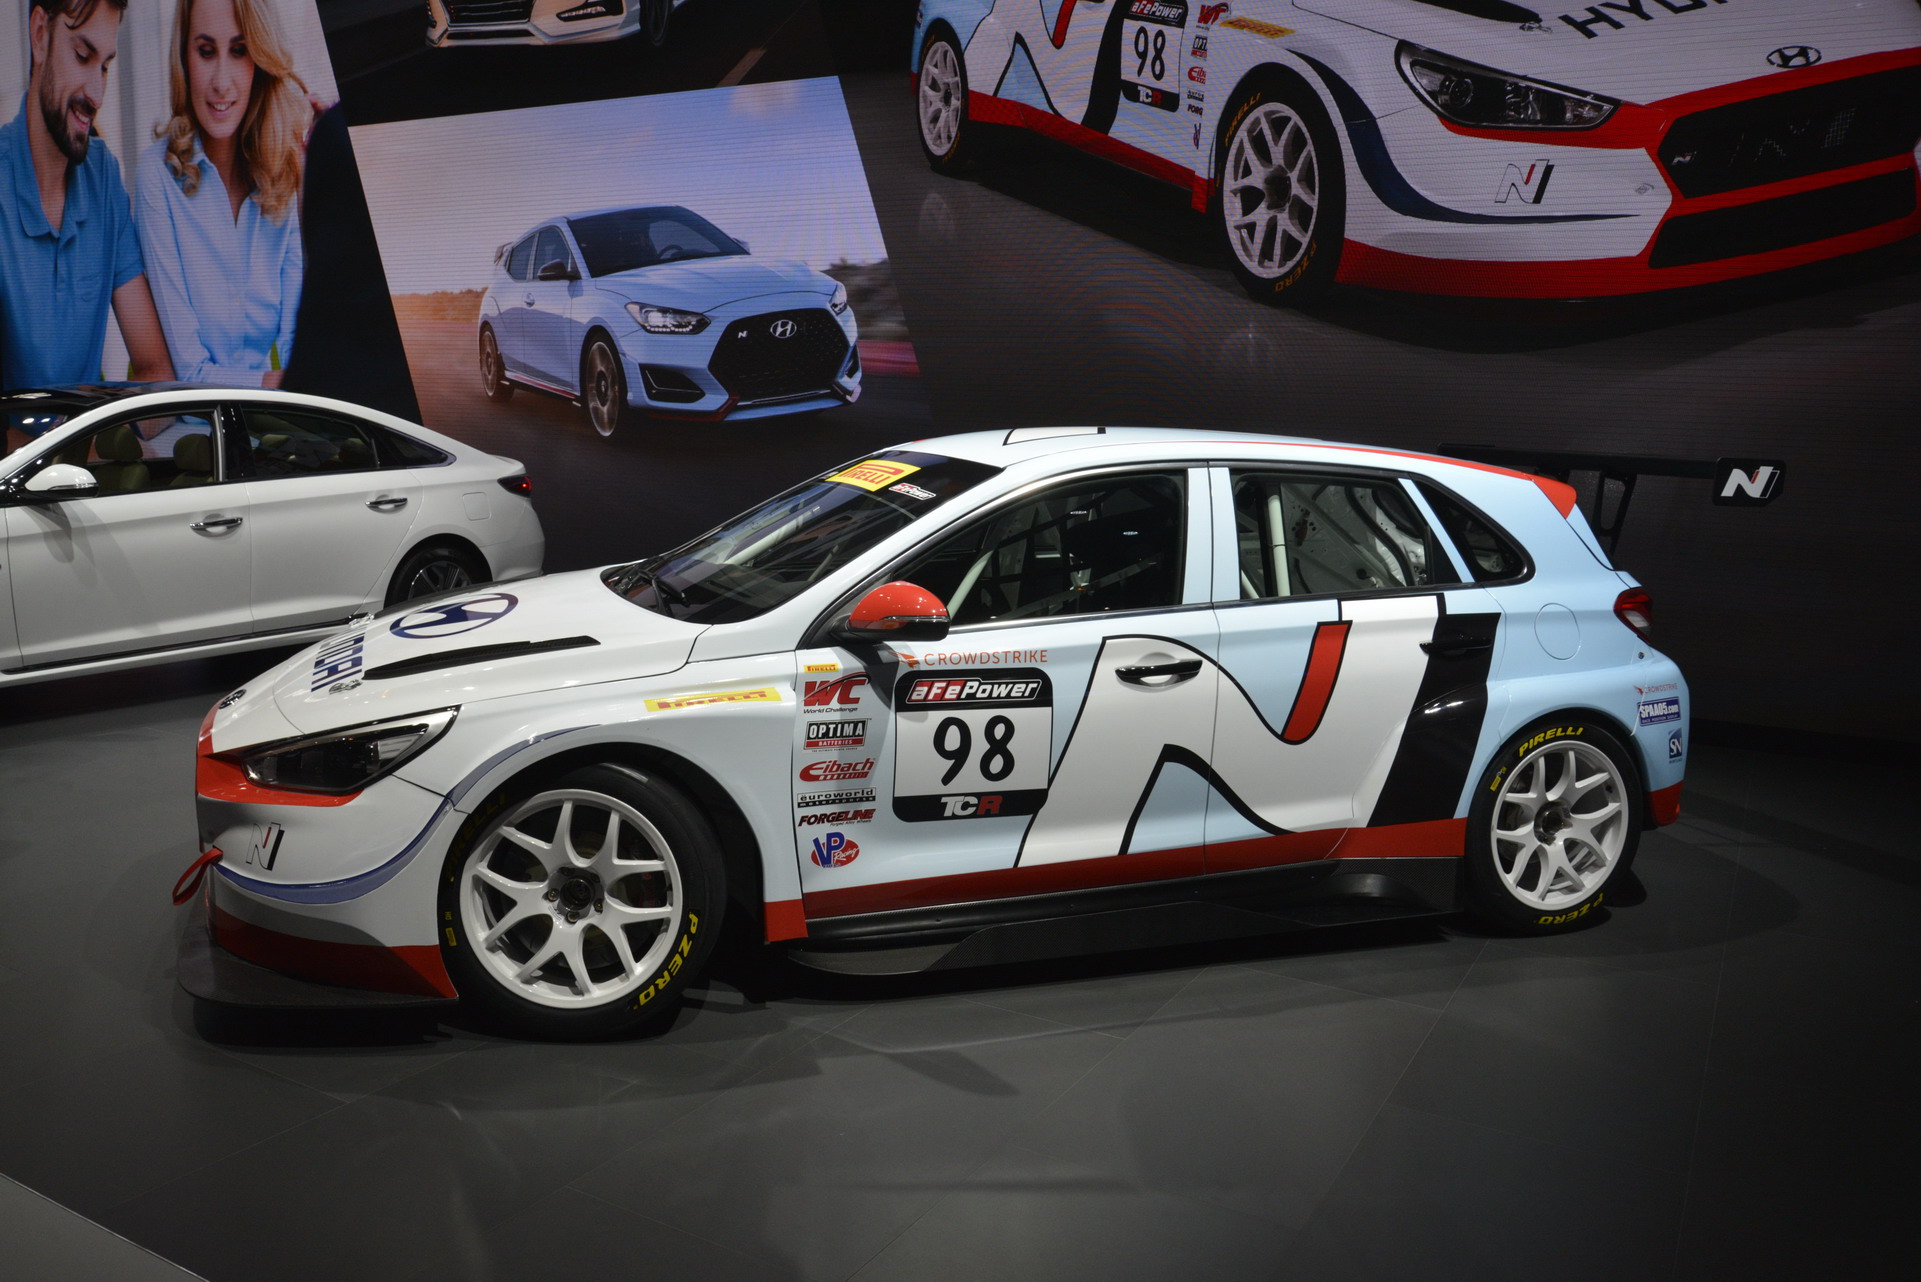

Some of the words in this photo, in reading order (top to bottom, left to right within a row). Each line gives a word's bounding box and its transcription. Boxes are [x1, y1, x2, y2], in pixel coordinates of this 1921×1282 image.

[1134, 26, 1166, 81] 98
[1138, 86, 1162, 105] TCR
[839, 463, 905, 485] PIRELLI
[924, 650, 1048, 666] CROWDSTRIKE
[803, 679, 867, 706] WC
[911, 680, 1037, 700] aFePower
[809, 722, 863, 739] OPTIMA
[933, 714, 1015, 786] 98
[1519, 726, 1584, 758] PIRELLI
[799, 758, 875, 782] Eibach
[799, 796, 874, 807] motorsports
[941, 795, 1003, 817] TCR
[798, 809, 876, 827] FORGELINE
[812, 832, 845, 868] VP
[832, 847, 859, 863] Racing
[1593, 892, 1604, 908] P
[689, 911, 699, 935] P
[1537, 907, 1592, 925] ZERO
[638, 936, 693, 1007] ZERO
